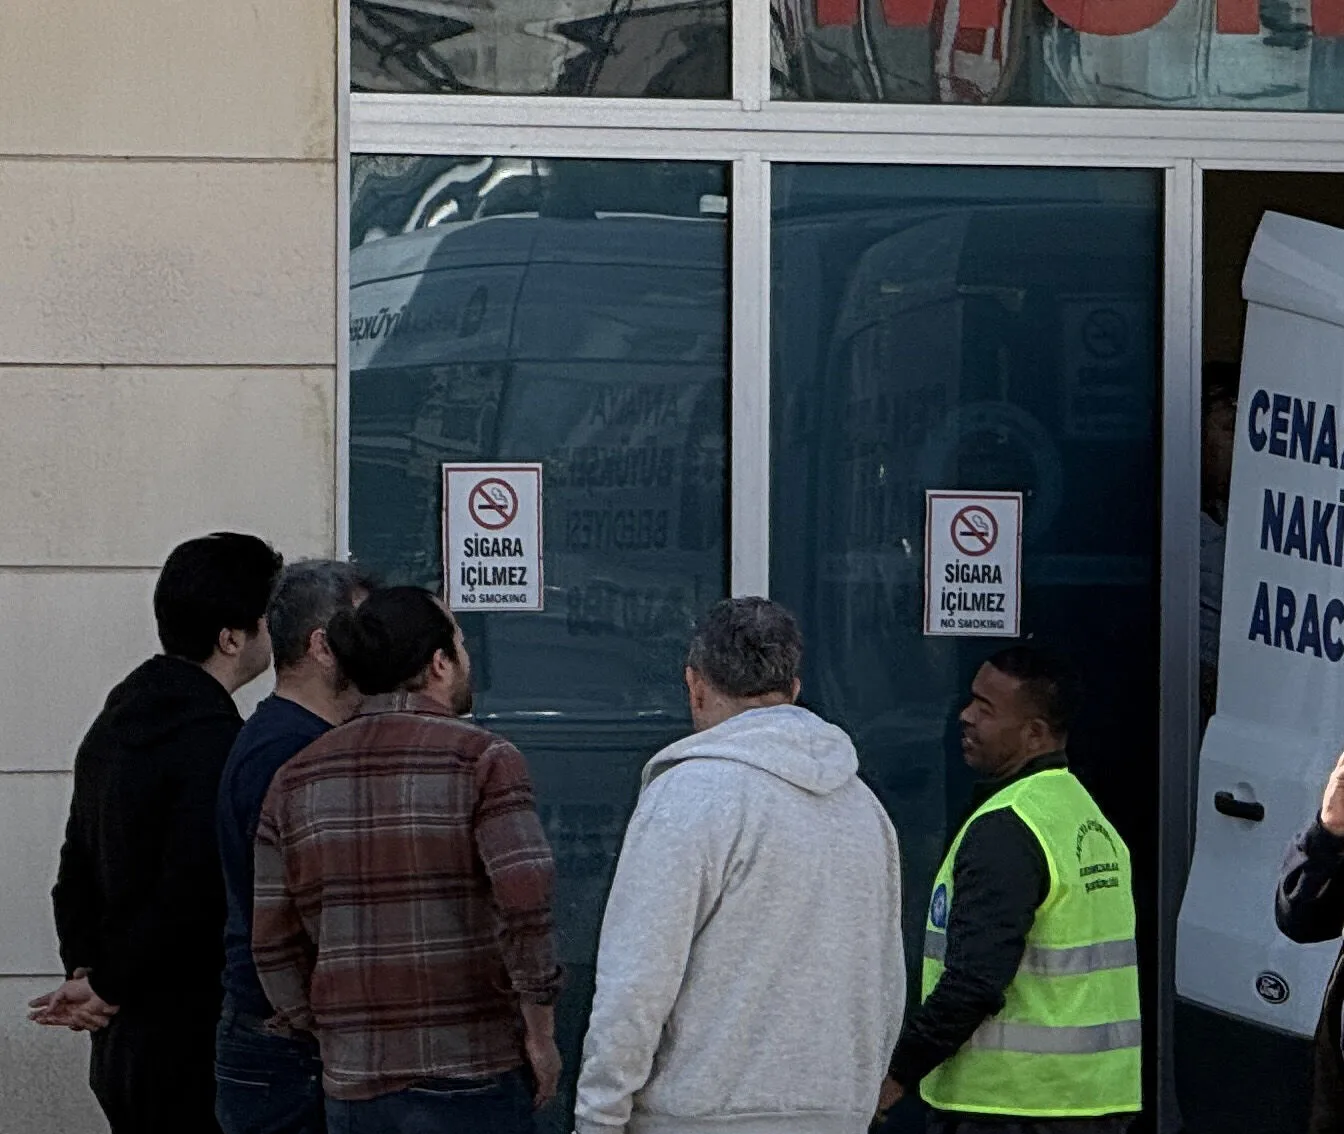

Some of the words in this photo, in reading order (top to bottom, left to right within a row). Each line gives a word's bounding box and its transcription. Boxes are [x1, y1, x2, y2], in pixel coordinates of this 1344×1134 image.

[463, 533, 524, 557] SİGARA
[461, 562, 528, 591] İÇİLMEZ
[945, 559, 1002, 584] SİGARA
[461, 594, 476, 603] NO
[479, 594, 527, 603] SMOKING
[940, 587, 1005, 616] İÇİLMEZ
[940, 618, 954, 629] NO
[957, 618, 1004, 629] SMOKING
